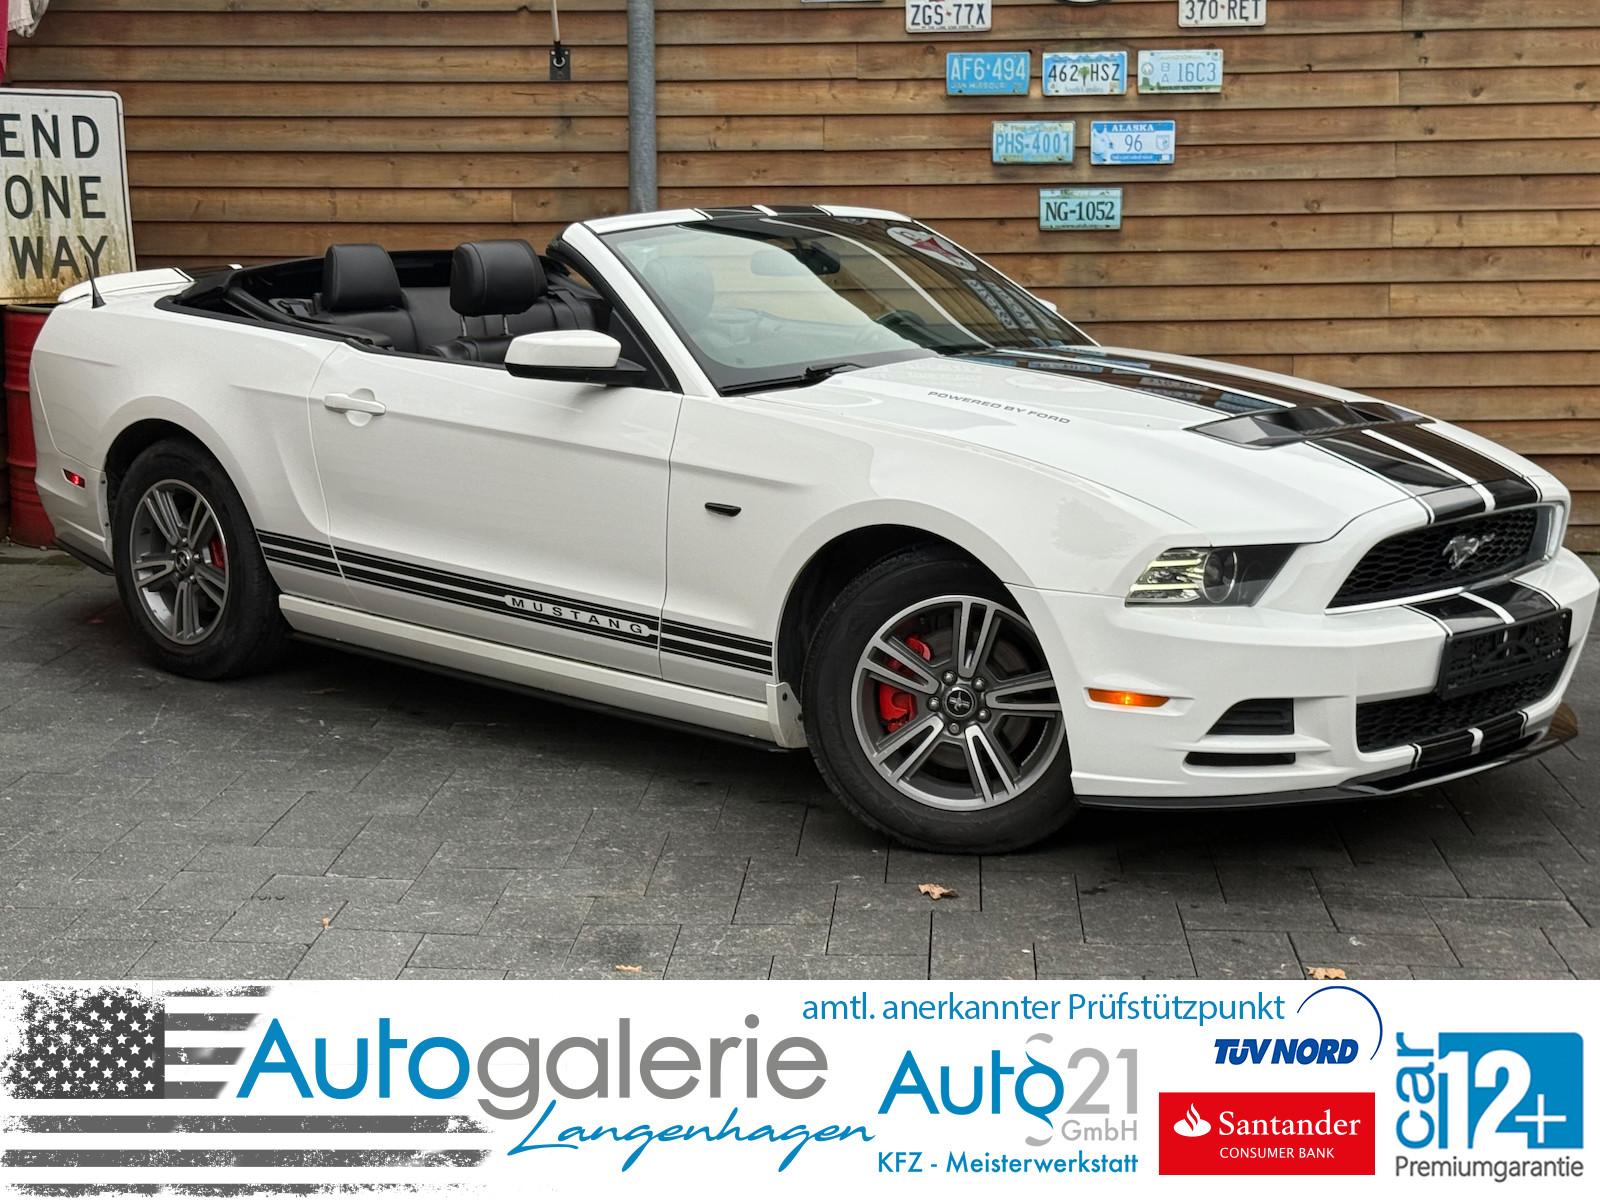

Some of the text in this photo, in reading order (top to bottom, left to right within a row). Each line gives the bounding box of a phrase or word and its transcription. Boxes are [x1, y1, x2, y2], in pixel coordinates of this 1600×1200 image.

[1177, 62, 1216, 82] 16C3
[0, 114, 99, 158] END
[1111, 124, 1154, 132] ALASKA
[996, 132, 1070, 154] PHS-4001
[1125, 134, 1143, 152] 96
[5, 175, 106, 219] ONE
[1045, 201, 1115, 221] NG-1052
[10, 236, 108, 279] WAY
[928, 391, 1071, 424] POWERED BY FORD
[511, 597, 643, 634] MUSTANG
